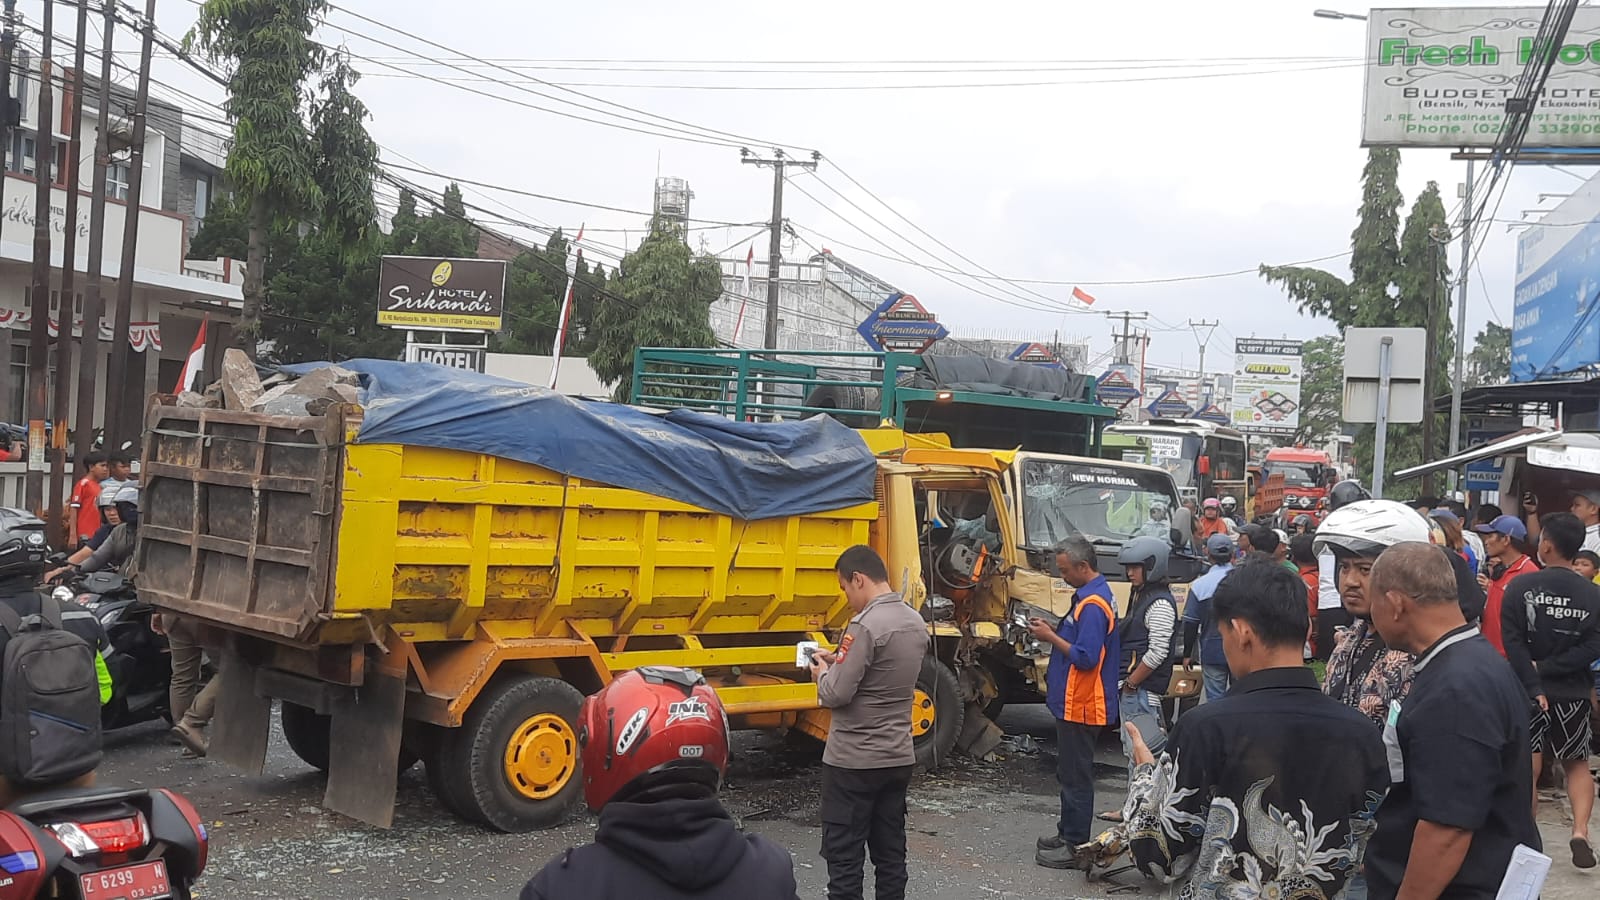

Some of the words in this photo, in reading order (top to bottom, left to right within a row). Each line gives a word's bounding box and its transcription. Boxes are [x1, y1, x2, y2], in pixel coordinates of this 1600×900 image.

[1378, 35, 1499, 66] Fresh
[1403, 87, 1512, 99] BUDGET
[1422, 113, 1500, 121] Martadinata
[1406, 123, 1467, 134] Phone.
[387, 284, 492, 313] Srikandi
[439, 289, 478, 299] HOTEL
[872, 322, 940, 335] International
[420, 350, 475, 371] HOTEL
[1072, 474, 1095, 483] NEW
[1096, 475, 1138, 487] NORMAL
[1535, 592, 1571, 606] dear
[1546, 606, 1590, 621] agony
[669, 703, 707, 713] INK
[619, 711, 643, 750] INK
[682, 747, 701, 756] DOT
[84, 877, 94, 893] Z
[101, 870, 134, 889] 6299
